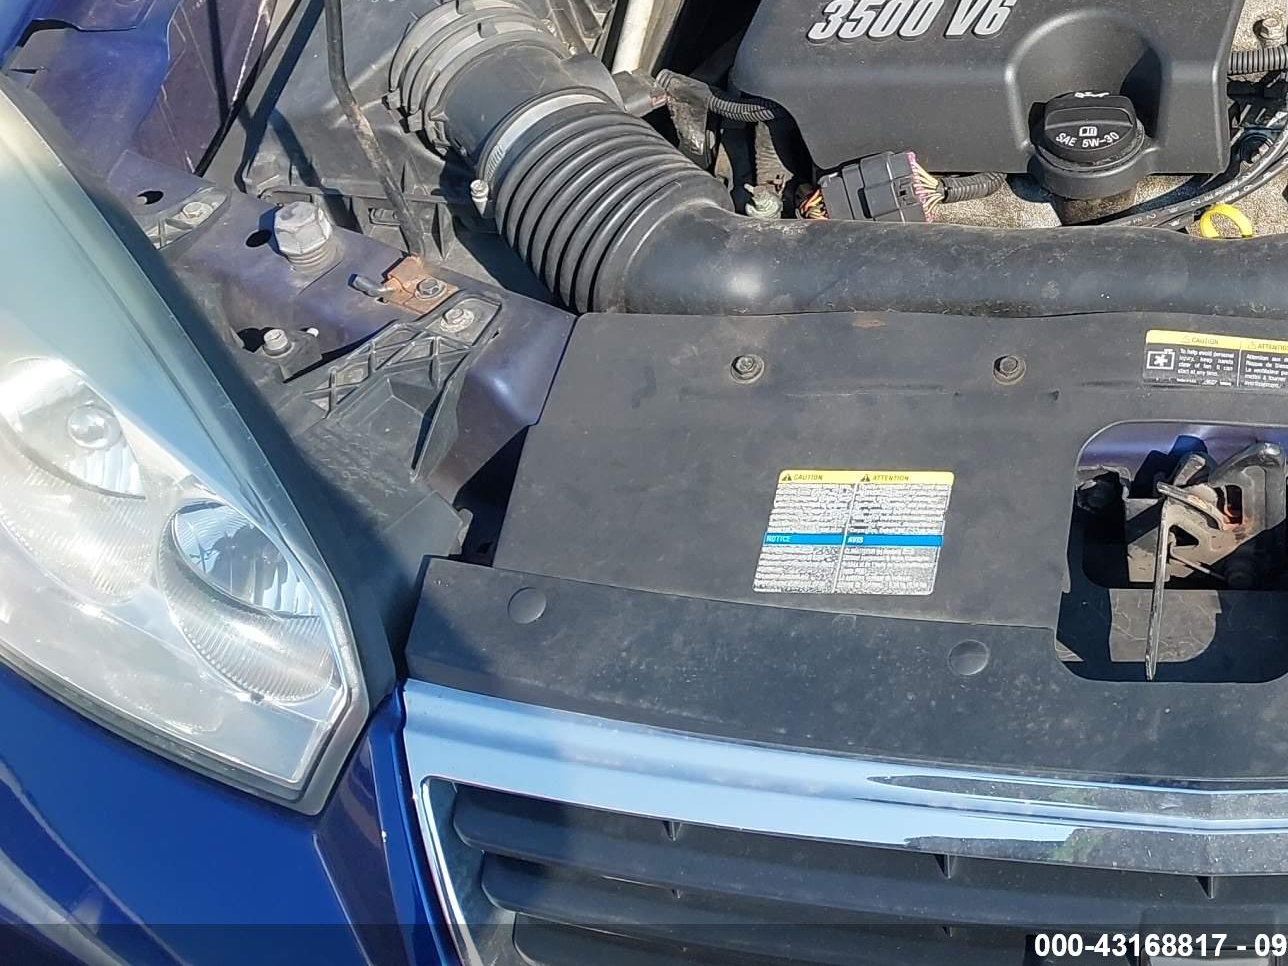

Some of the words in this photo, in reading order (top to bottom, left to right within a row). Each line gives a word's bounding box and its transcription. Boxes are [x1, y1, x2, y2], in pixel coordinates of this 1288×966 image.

[1056, 132, 1077, 147] SAE
[1081, 131, 1120, 148] 5W-30
[1191, 337, 1219, 345] CAUTION
[793, 473, 823, 481] CAUTION
[872, 474, 910, 482] ATTENTION
[766, 535, 792, 543] NOTICE
